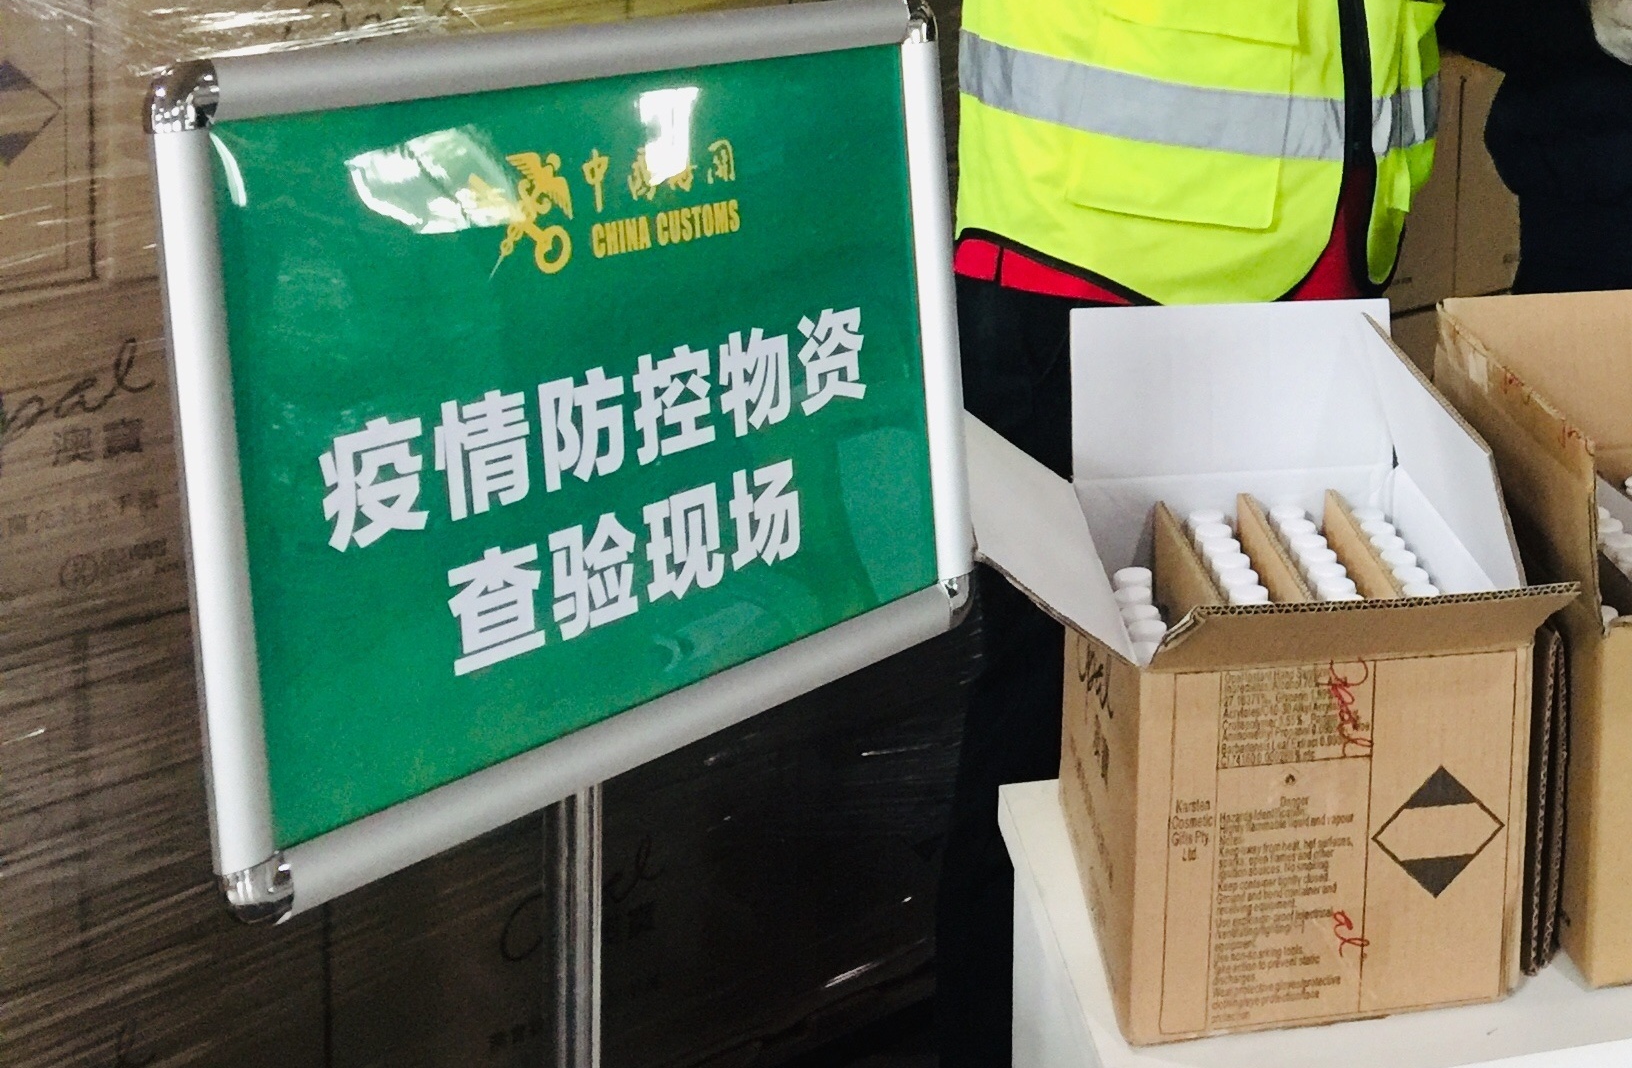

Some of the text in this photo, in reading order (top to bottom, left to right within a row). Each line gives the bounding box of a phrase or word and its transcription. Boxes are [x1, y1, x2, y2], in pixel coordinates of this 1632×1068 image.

[591, 197, 741, 259] CHINA CUSTOMS
[318, 306, 867, 554] 疫情防控物资
[447, 458, 802, 677] 查验现场
